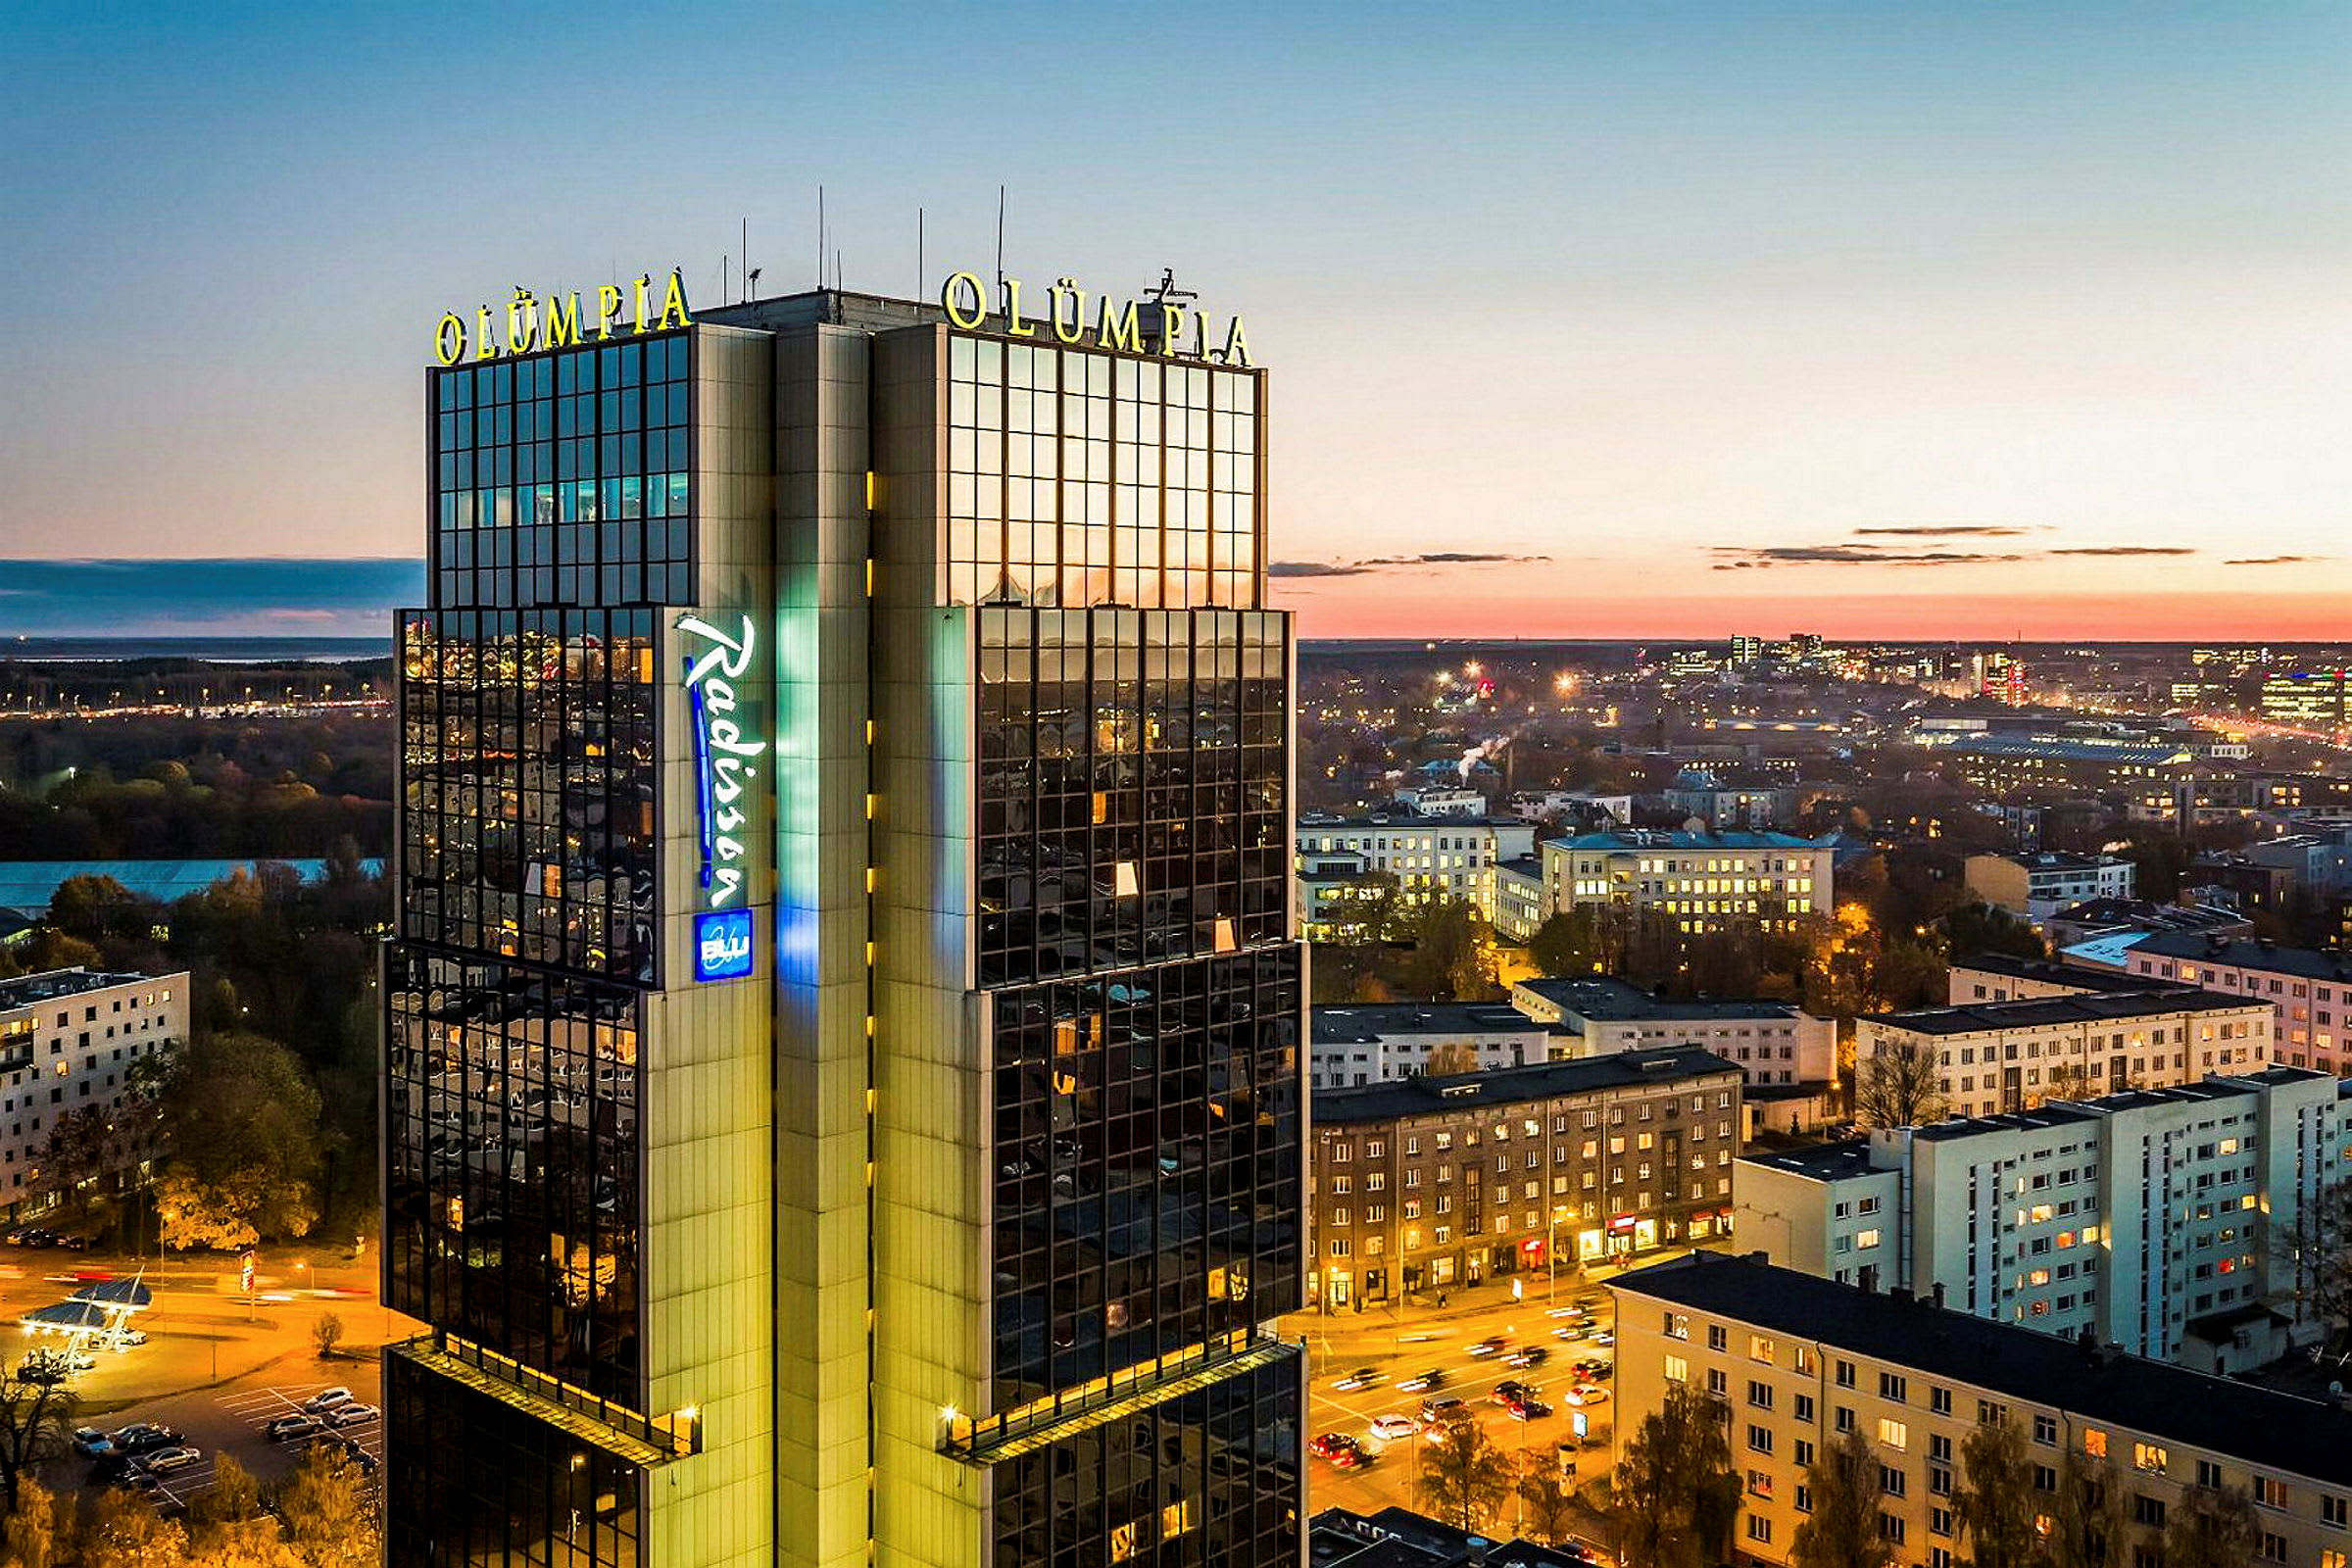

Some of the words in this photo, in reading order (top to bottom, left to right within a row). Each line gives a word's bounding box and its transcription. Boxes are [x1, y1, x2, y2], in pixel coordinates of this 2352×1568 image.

[435, 269, 692, 366] OLÜMPIA
[943, 271, 1252, 367] OLÜMPIA
[674, 613, 766, 906] Radisson
[701, 935, 750, 960] BLU
